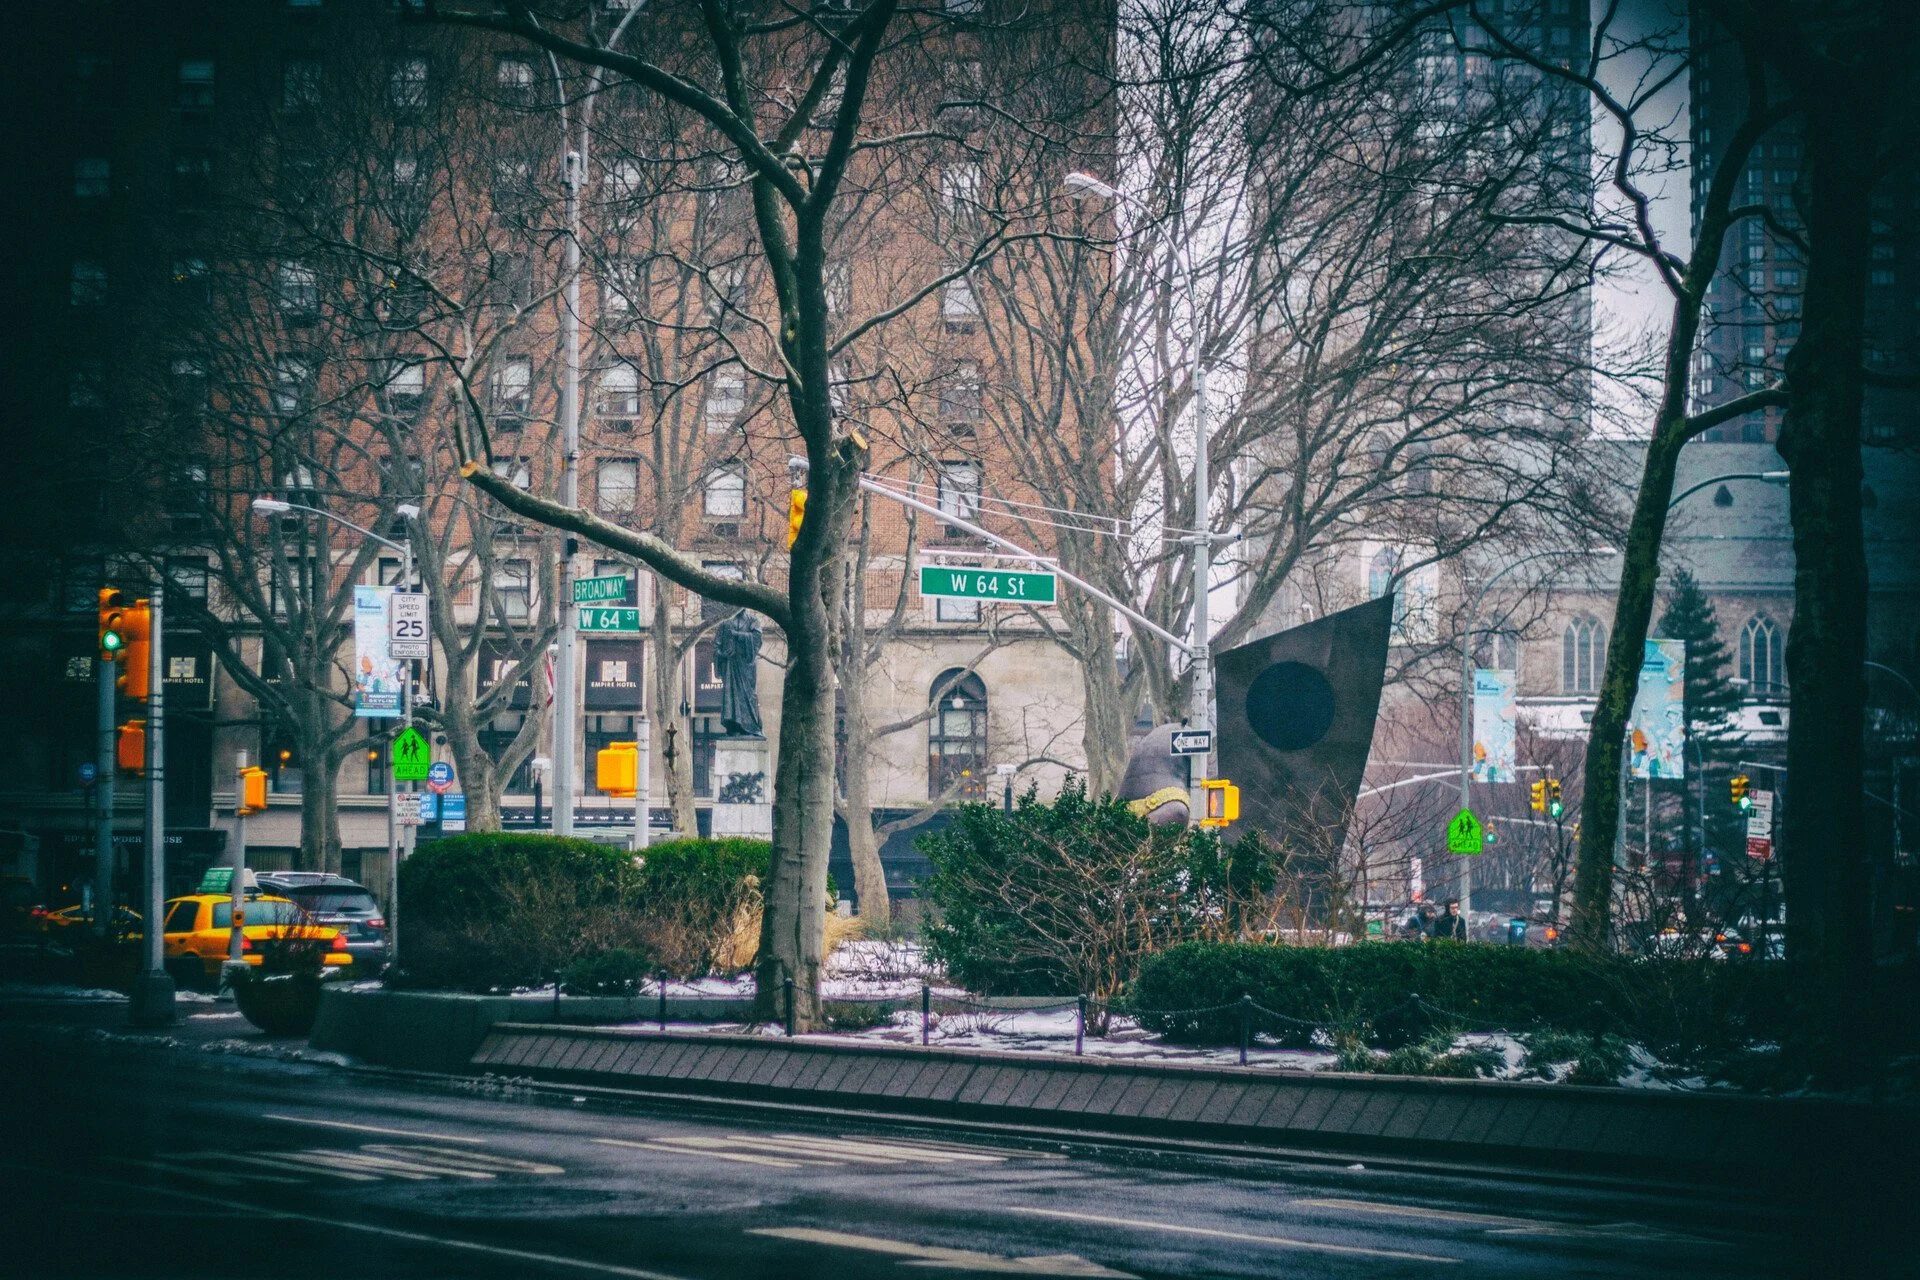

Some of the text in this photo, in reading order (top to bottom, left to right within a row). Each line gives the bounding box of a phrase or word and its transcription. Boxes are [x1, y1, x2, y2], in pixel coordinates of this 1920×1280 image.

[574, 579, 624, 600] BROADWAY
[951, 574, 1025, 596] W 64 St
[581, 610, 636, 629] W 64 ST
[396, 620, 424, 637] 25
[1193, 737, 1207, 746] WAY
[396, 765, 426, 775] AHEAD
[1452, 840, 1479, 850] AHEAD
